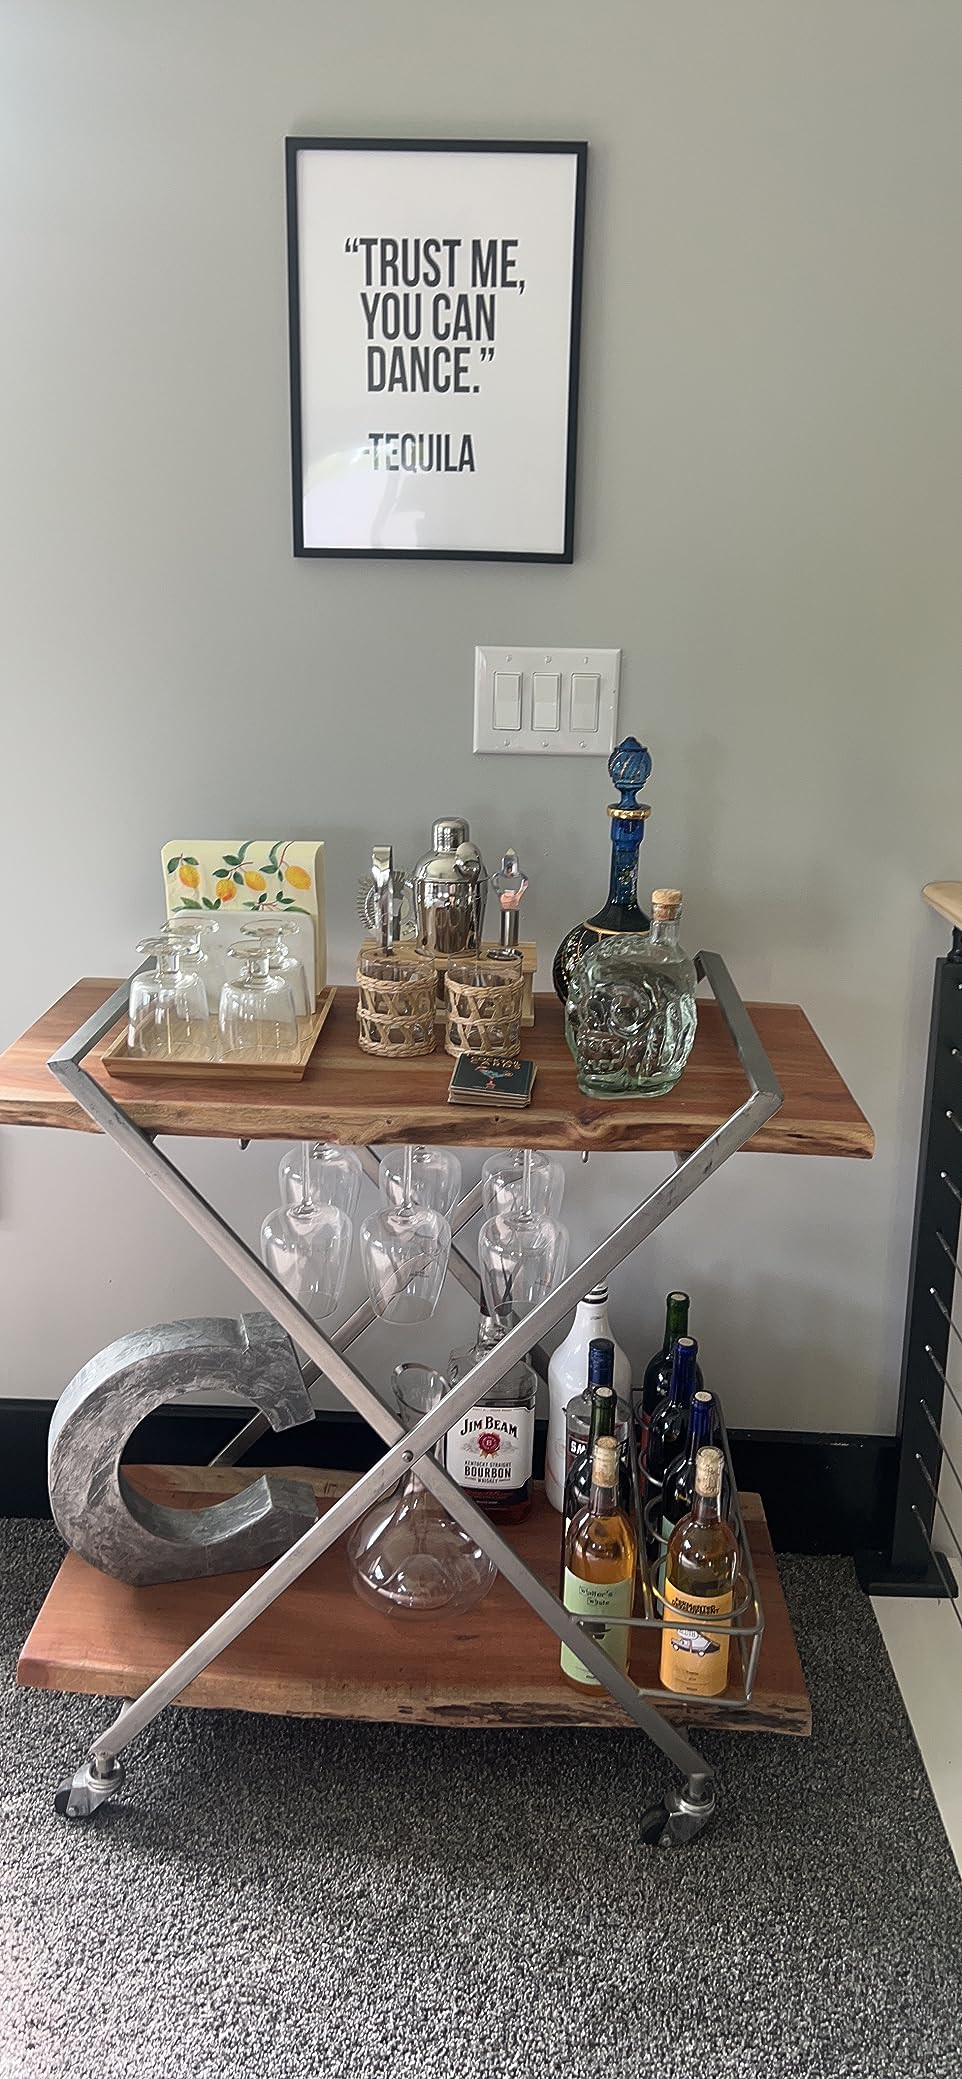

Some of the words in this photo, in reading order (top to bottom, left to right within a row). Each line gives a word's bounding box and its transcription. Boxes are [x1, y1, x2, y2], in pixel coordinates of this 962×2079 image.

[345, 238, 461, 287] “TRUST
[471, 239, 526, 294] ME,
[360, 292, 422, 340] YOU
[432, 293, 496, 342] CAN
[366, 346, 495, 394] DANCE.”
[362, 433, 476, 473] -TEQUILA
[460, 1418, 482, 1436] JIM
[485, 1416, 518, 1439] BEAM
[464, 1465, 511, 1479] BOURBON
